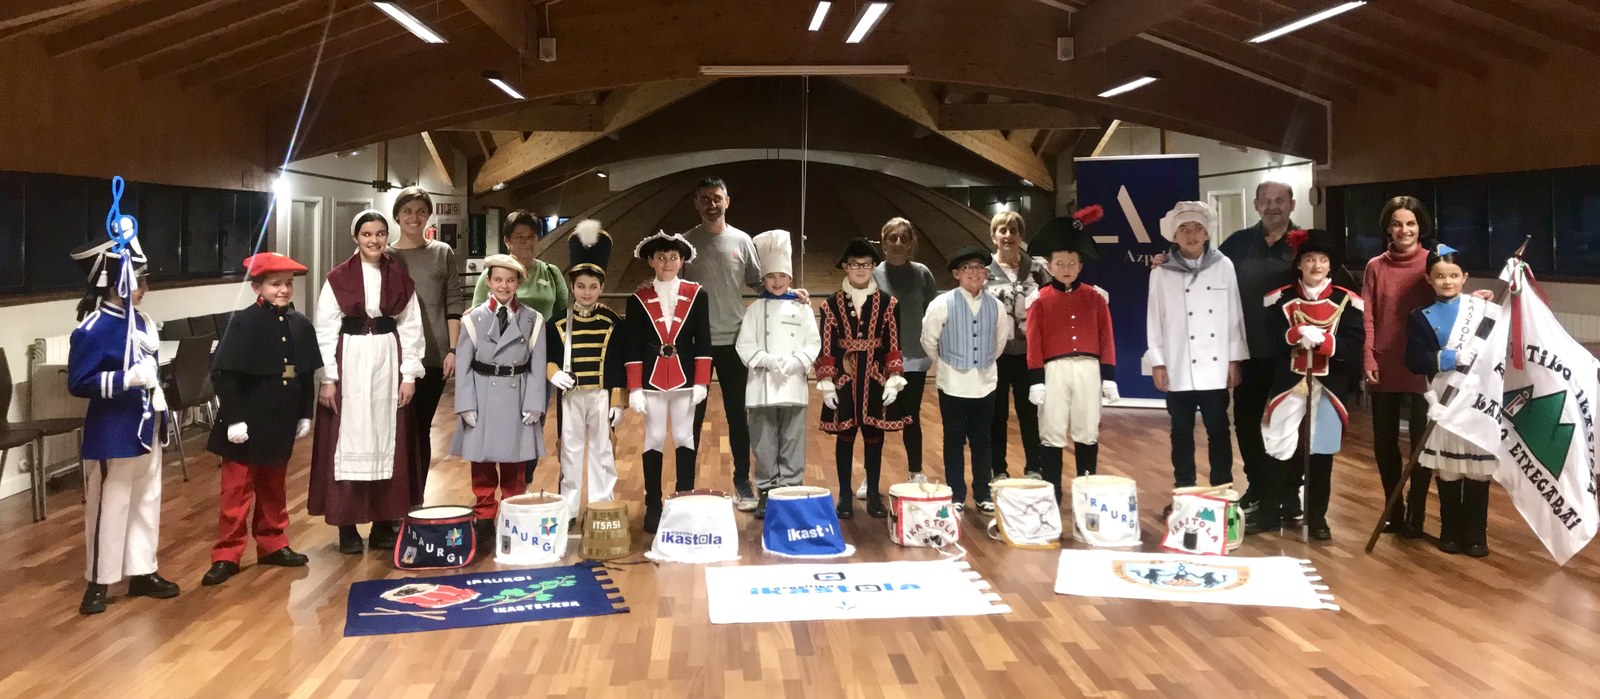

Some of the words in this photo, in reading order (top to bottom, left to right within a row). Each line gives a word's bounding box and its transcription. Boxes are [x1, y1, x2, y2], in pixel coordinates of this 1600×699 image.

[592, 520, 621, 530] ITSASI
[906, 518, 956, 540] IKASTOLA
[1171, 517, 1219, 543] IKASTOLA
[407, 525, 463, 564] IRAURGI
[661, 531, 722, 545] ikastola
